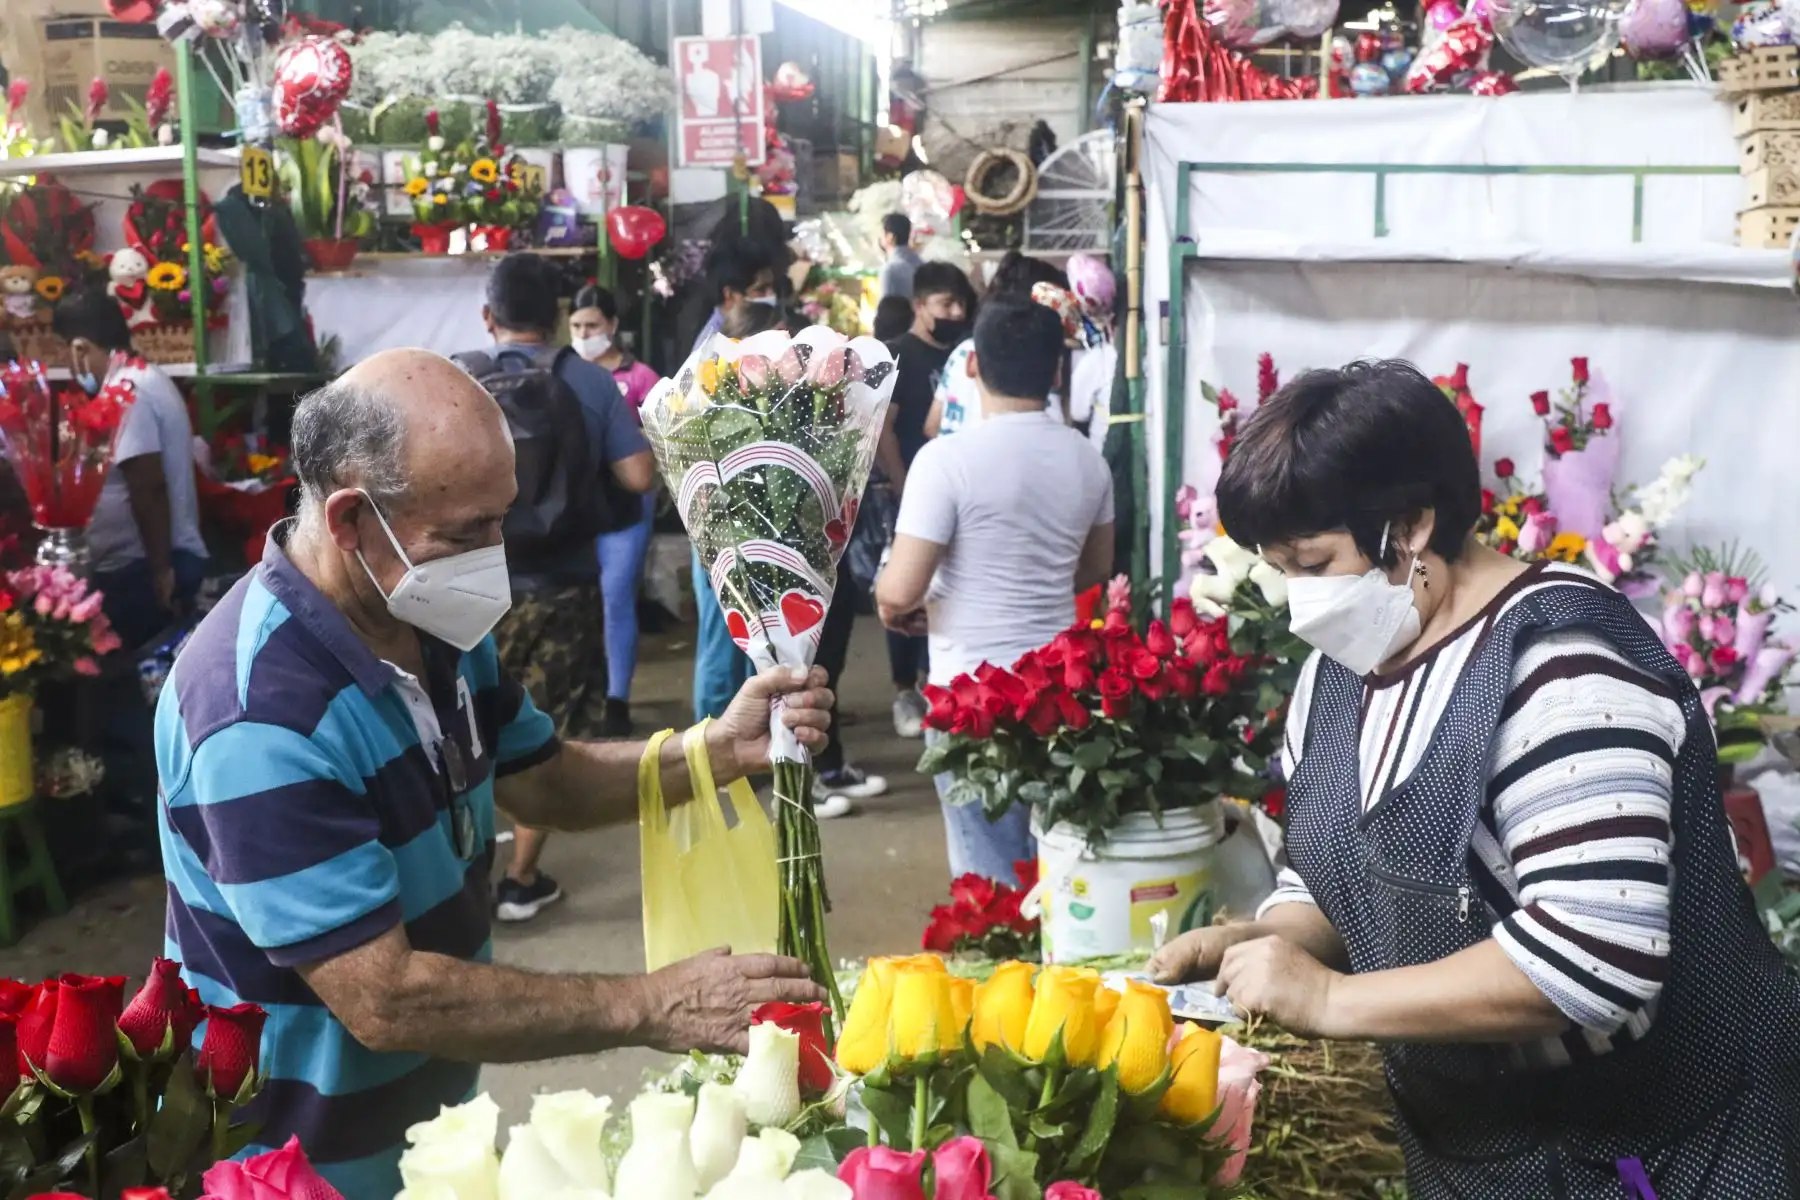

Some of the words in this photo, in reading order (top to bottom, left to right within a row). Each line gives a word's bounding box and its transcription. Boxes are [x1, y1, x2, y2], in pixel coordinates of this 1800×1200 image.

[700, 124, 744, 137] ALARM
[700, 136, 744, 148] CONTR
[246, 156, 268, 188] 13
